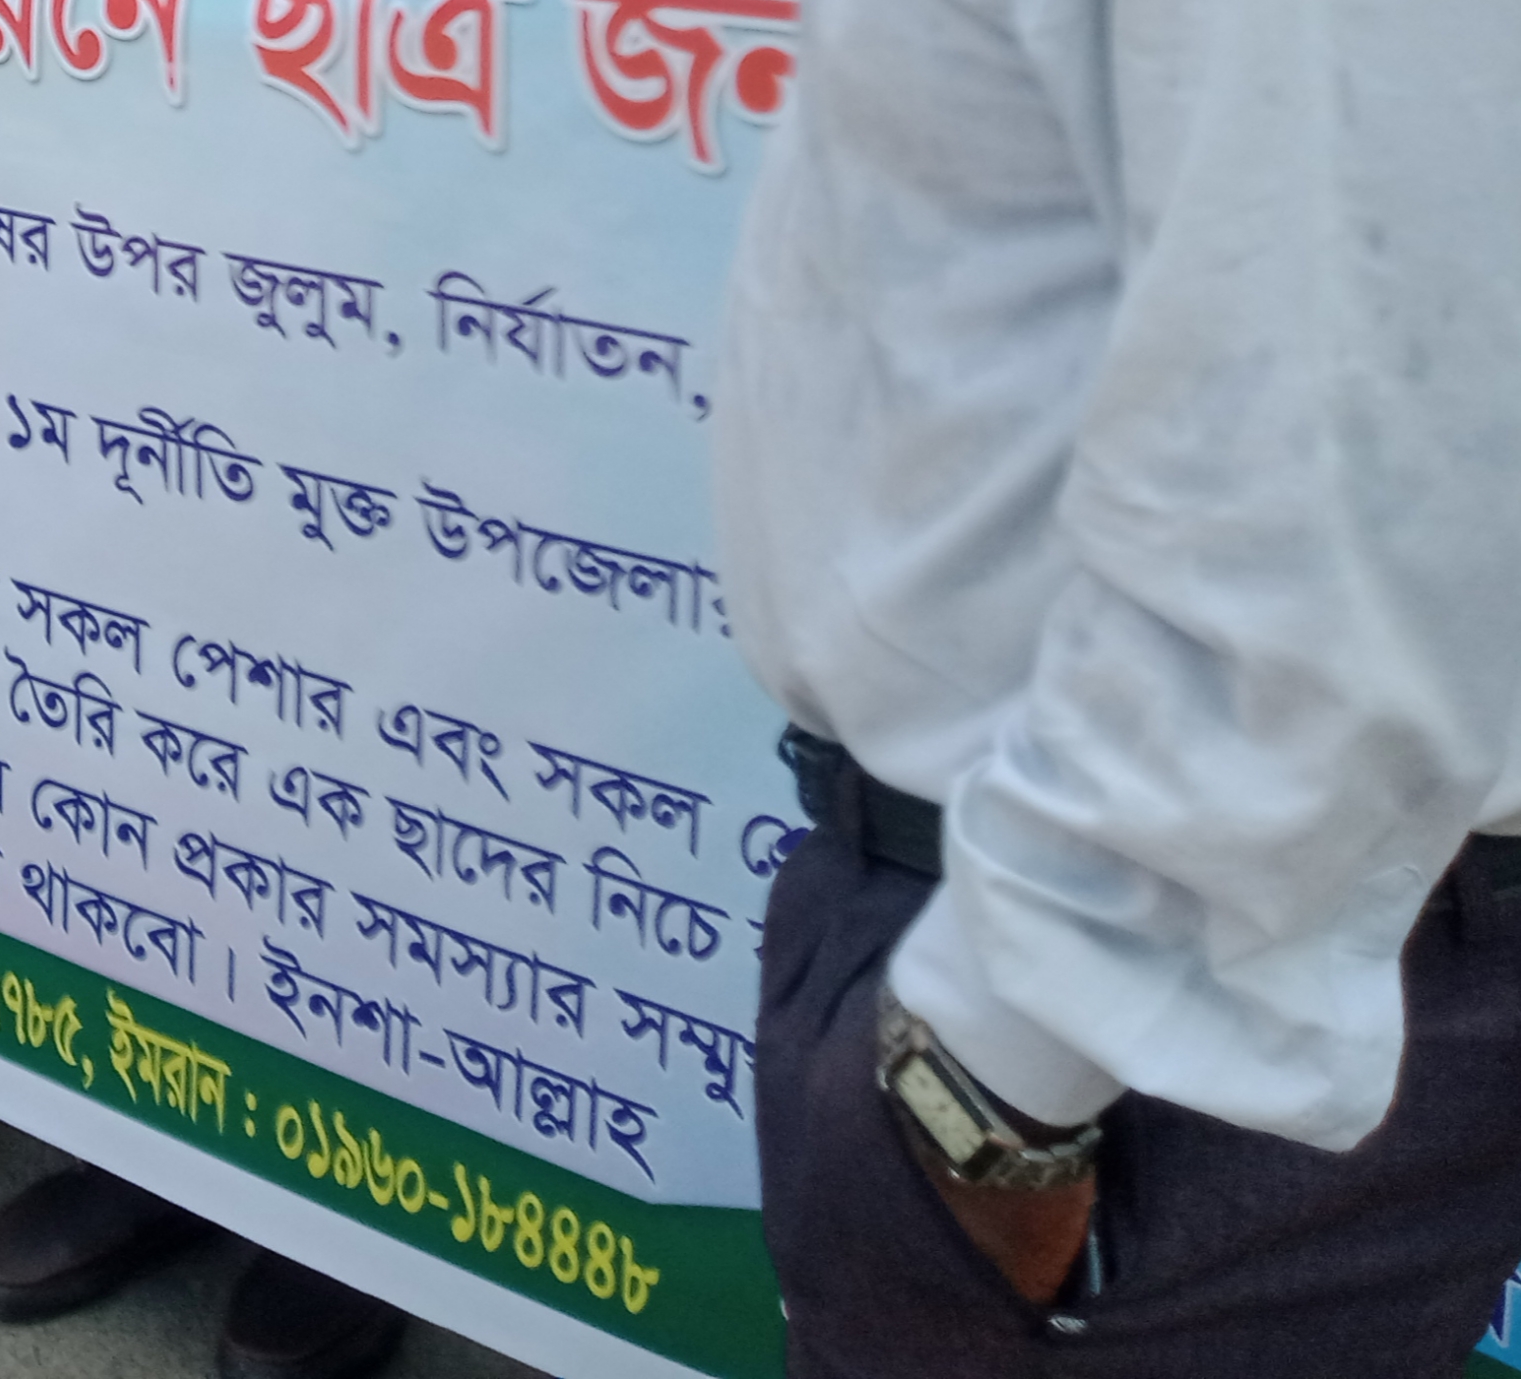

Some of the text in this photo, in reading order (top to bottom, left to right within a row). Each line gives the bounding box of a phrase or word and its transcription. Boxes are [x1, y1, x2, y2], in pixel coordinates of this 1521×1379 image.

[71, 205, 207, 301] উপর
[223, 252, 405, 356] জুলুম,
[426, 271, 711, 419] নির্যাতন,
[6, 394, 77, 464] ১ম
[277, 462, 398, 551] মুক্ত
[4, 645, 124, 758] তৈরি
[134, 708, 250, 802] করে
[269, 766, 372, 841] এক
[384, 795, 568, 916] ছাদের
[582, 845, 732, 961] নিচে
[12, 578, 151, 675] সকল
[173, 634, 355, 739] পেশার
[378, 703, 511, 803] এবং
[526, 740, 713, 860] সকল
[20, 859, 207, 986] থাকবো
[260, 935, 659, 1184] ইনশা-আল্লাহ
[30, 778, 159, 871] কোন
[174, 831, 336, 941] প্রকার
[350, 890, 598, 1040] সমস্যার
[613, 987, 757, 1121] সম্মু
[105, 986, 233, 1134] ইমরান
[275, 1098, 660, 1316] ০১৯৬০-১৮৪৪৪৮
